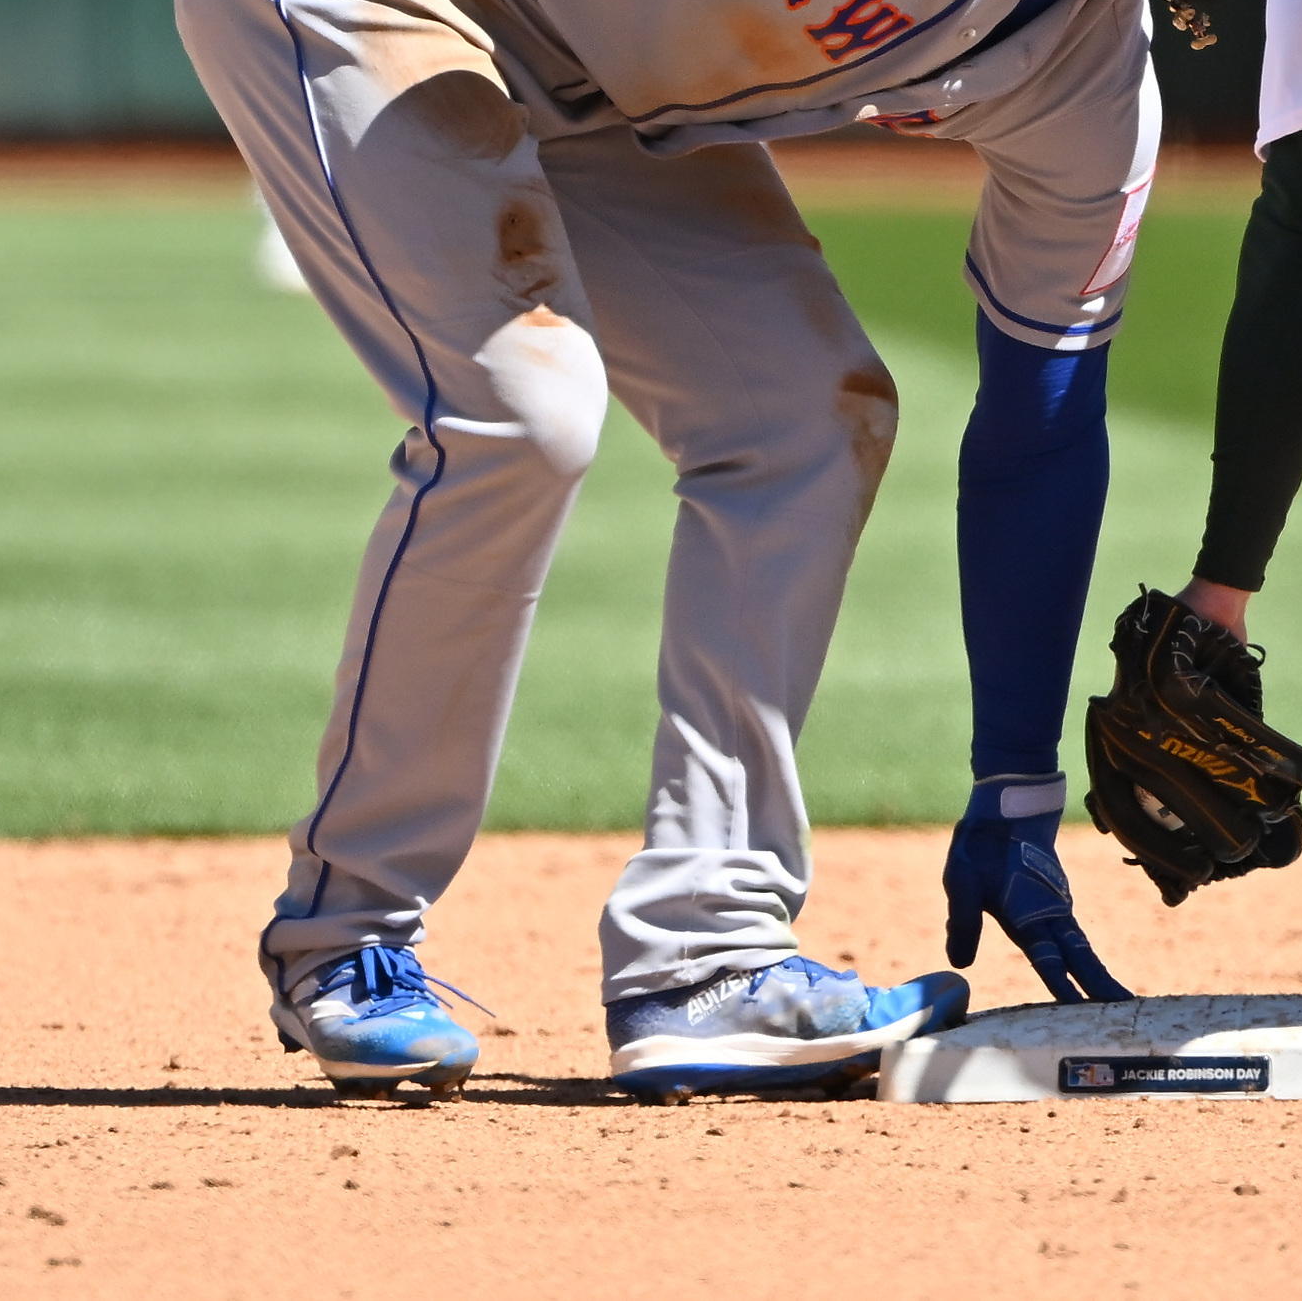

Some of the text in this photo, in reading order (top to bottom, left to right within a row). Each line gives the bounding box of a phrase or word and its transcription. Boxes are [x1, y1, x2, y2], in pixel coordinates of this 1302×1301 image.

[1122, 1068, 1262, 1081] JACKIE ROBINSON DAY
